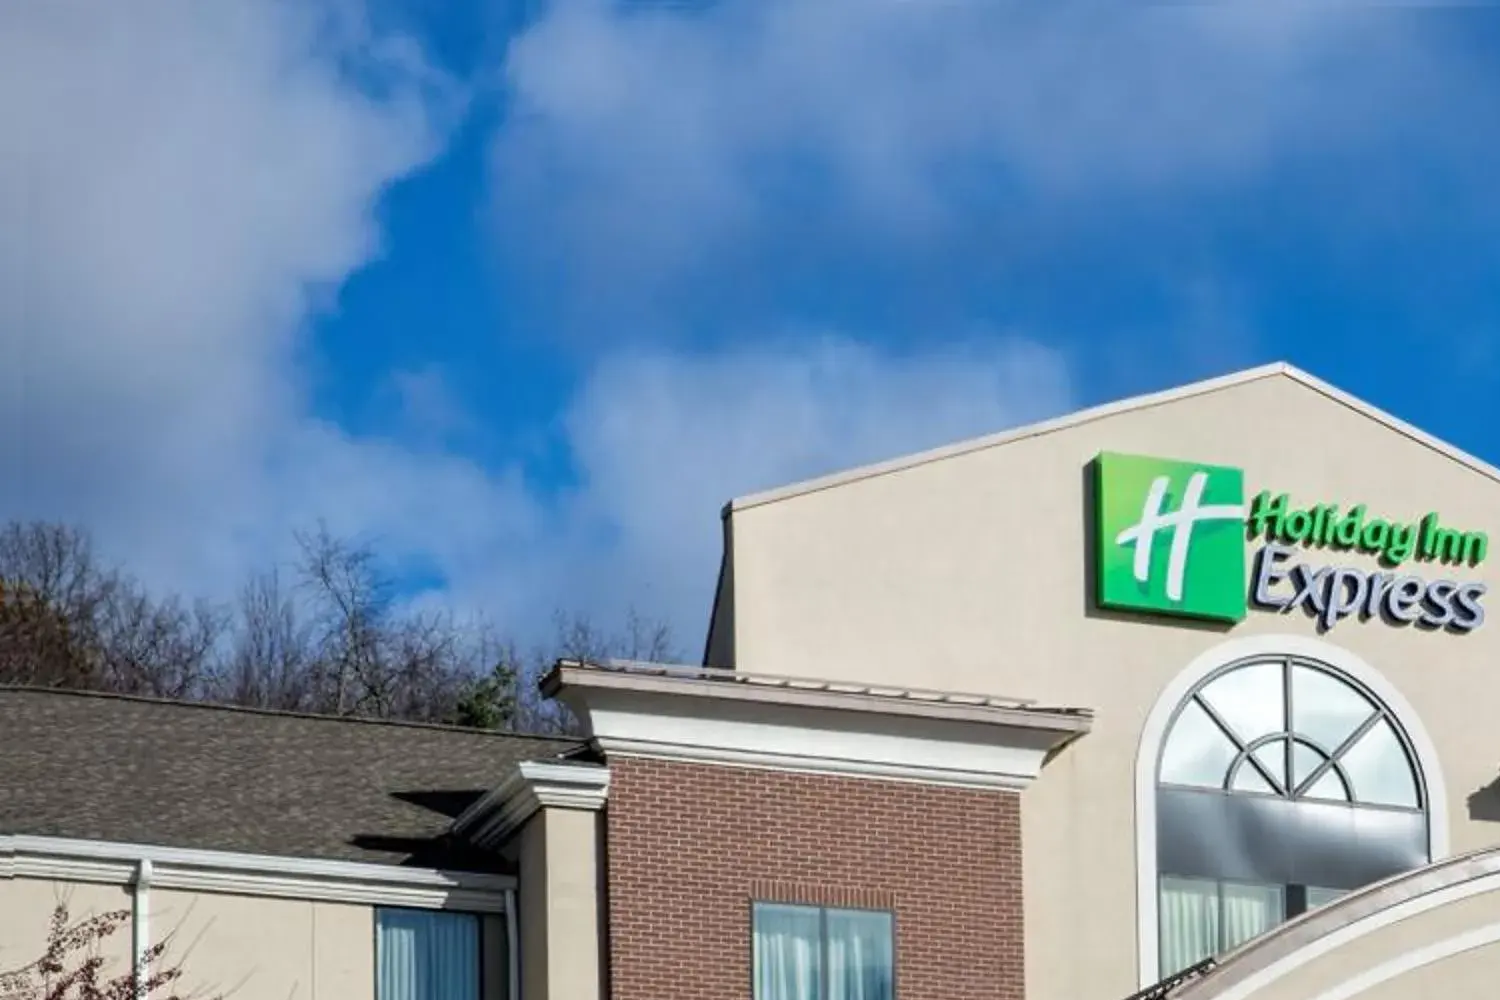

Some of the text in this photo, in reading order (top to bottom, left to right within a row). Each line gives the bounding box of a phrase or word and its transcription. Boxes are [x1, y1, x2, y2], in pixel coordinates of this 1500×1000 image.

[1117, 473, 1245, 601] H
[1248, 490, 1489, 565] Holiday Inn
[1250, 545, 1487, 632] Express
